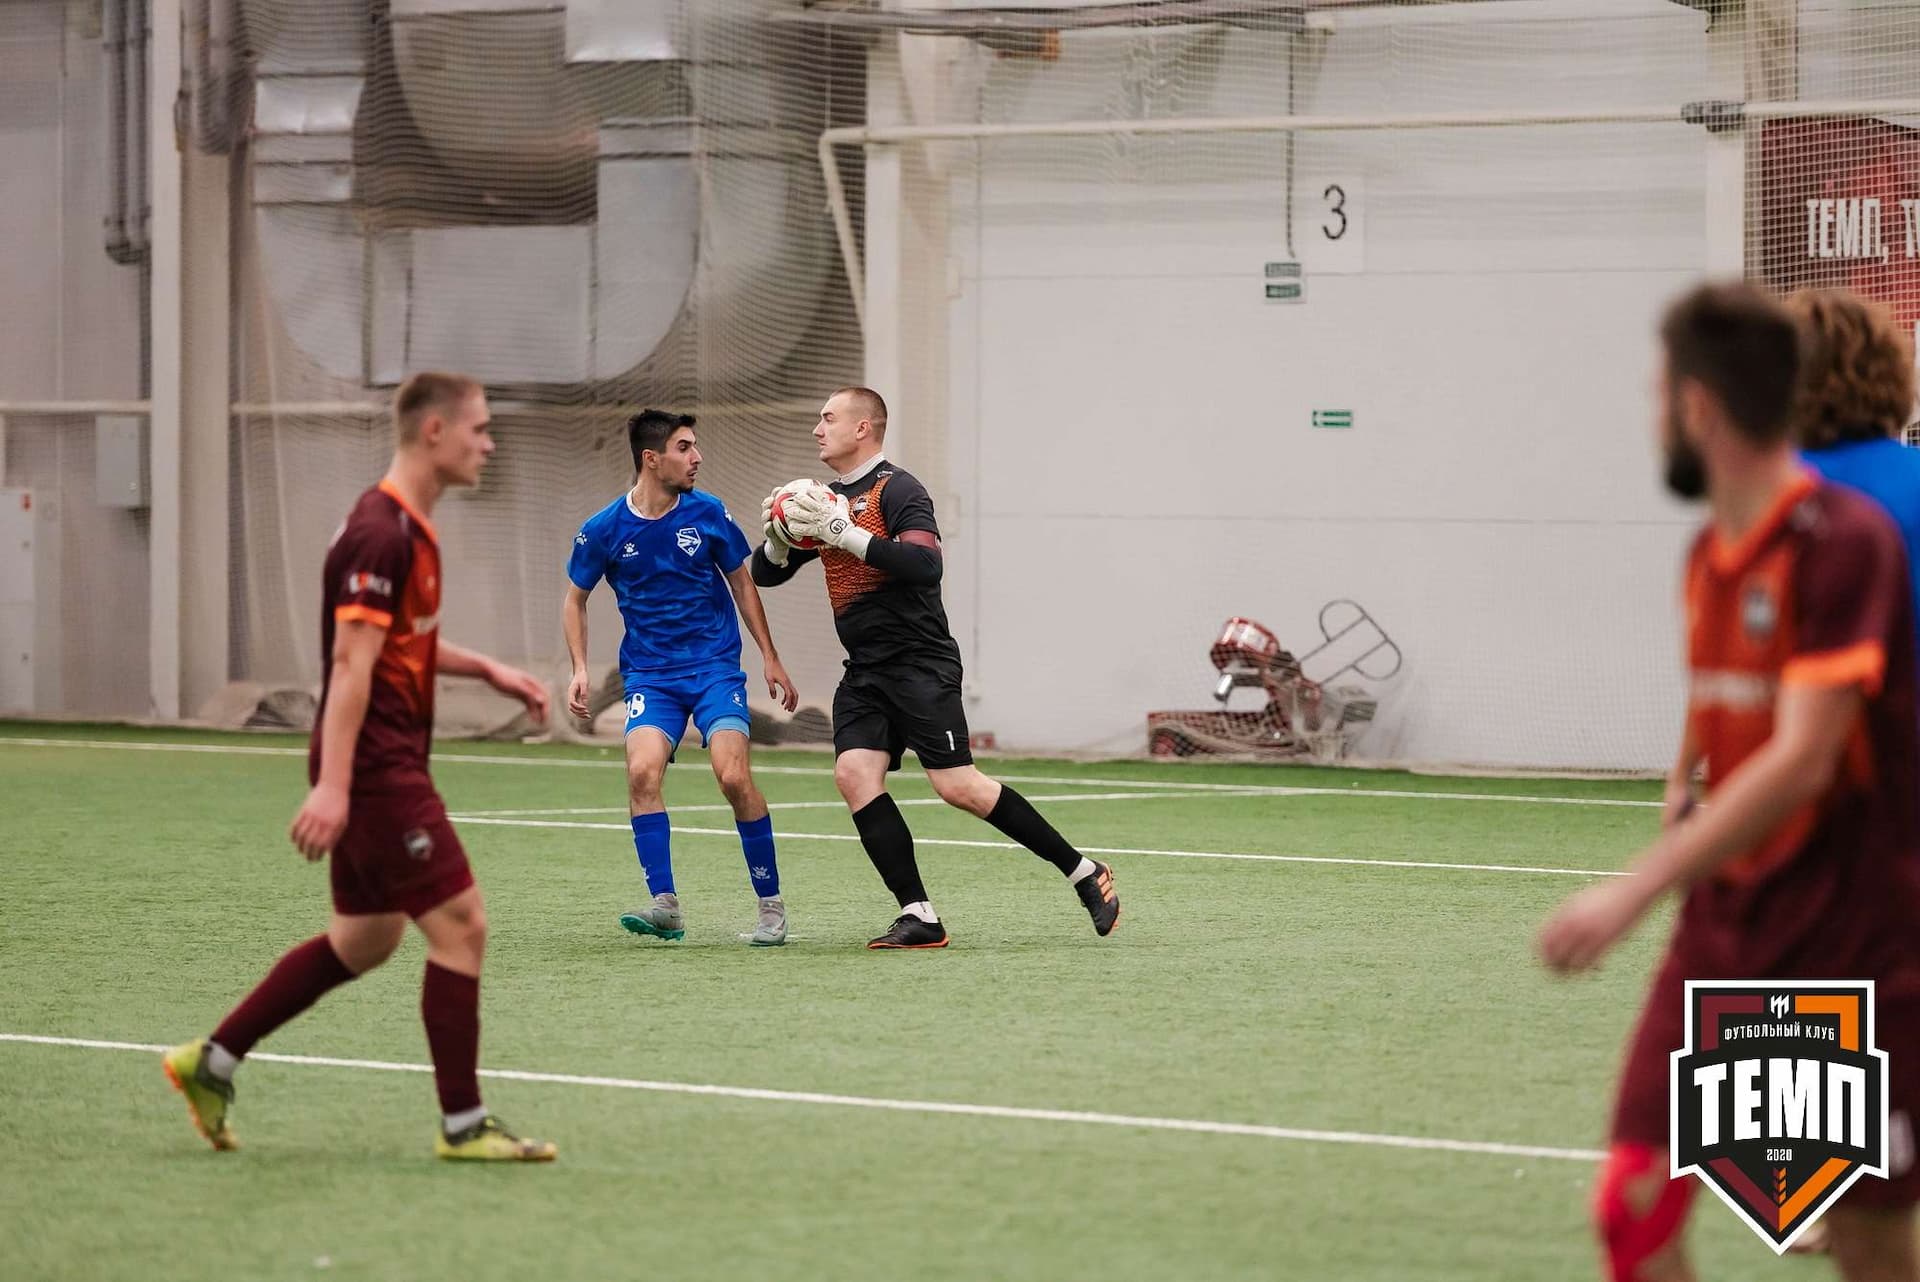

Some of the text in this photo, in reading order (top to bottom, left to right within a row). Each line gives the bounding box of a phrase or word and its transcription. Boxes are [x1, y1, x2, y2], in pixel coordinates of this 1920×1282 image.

[1322, 184, 1347, 240] 3
[1806, 198, 1889, 265] ТЕМП,
[945, 730, 955, 751] 1
